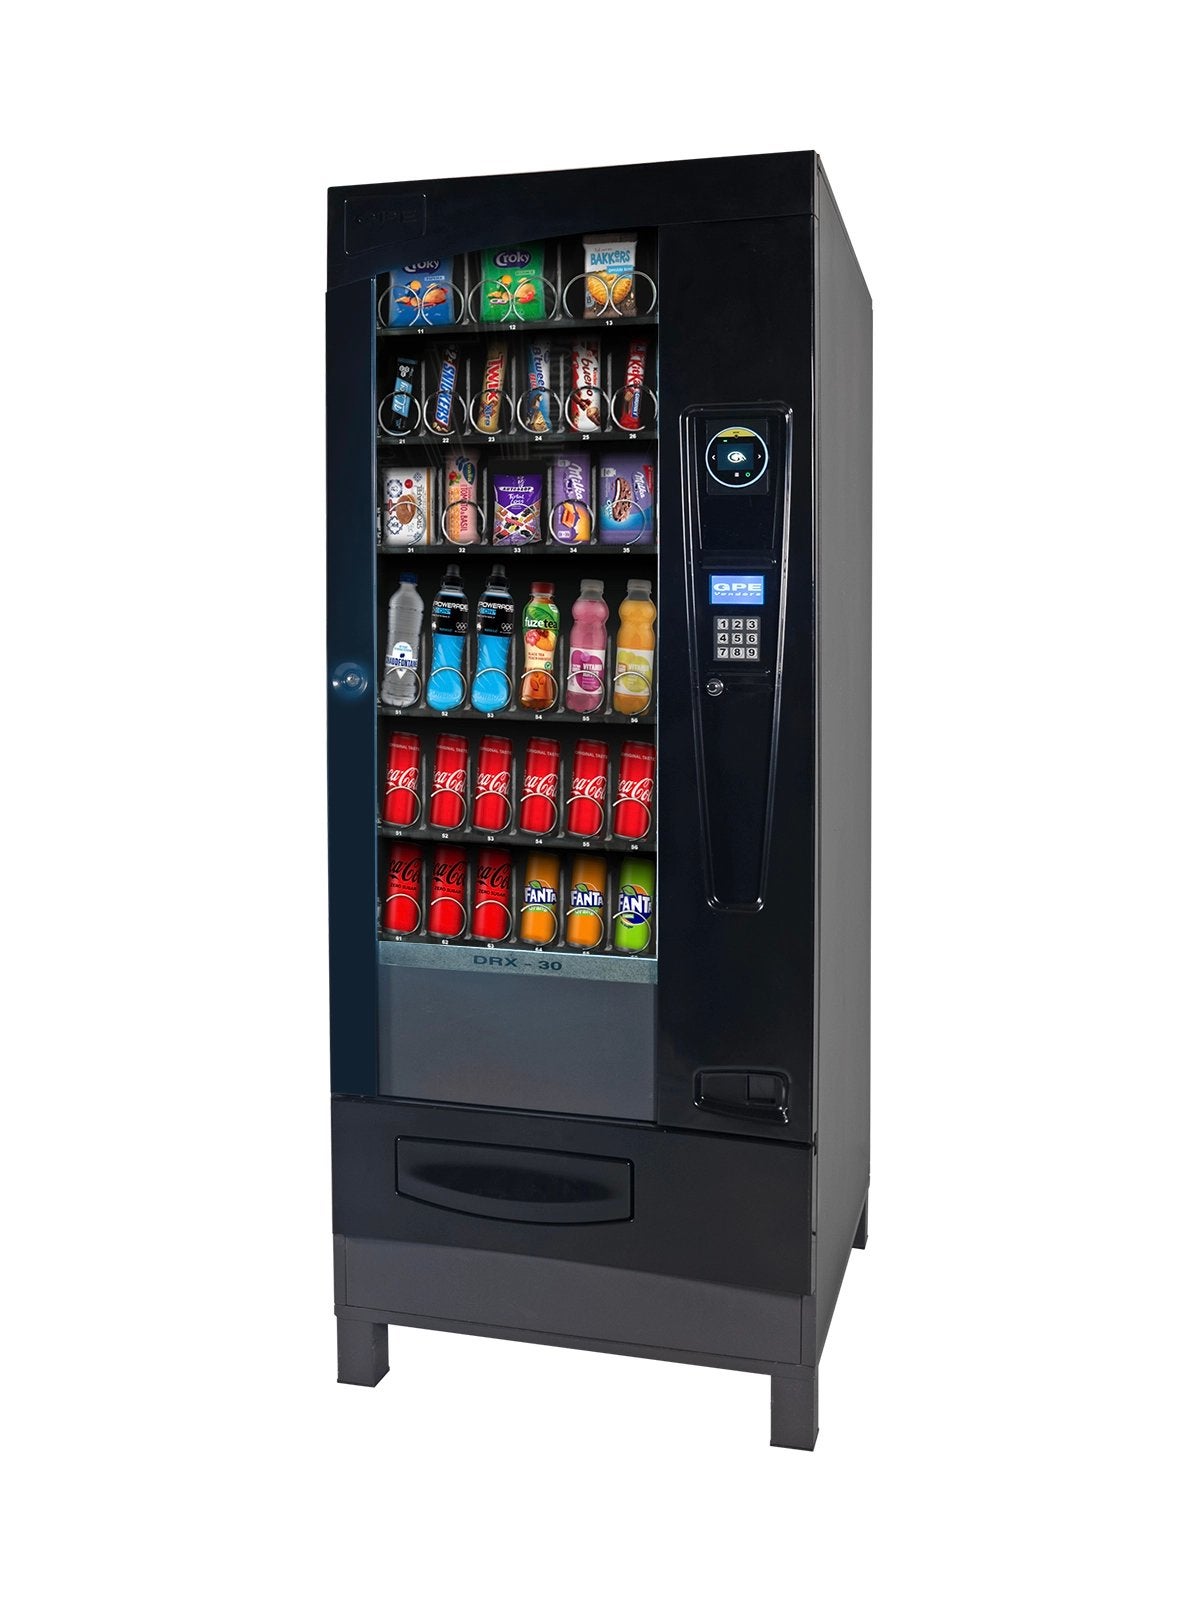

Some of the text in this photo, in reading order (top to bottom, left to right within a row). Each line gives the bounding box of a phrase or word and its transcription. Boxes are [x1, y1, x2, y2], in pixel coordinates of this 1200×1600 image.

[495, 251, 530, 267] Croky
[436, 362, 456, 425] SNICKERS
[568, 463, 585, 500] Milka
[635, 471, 647, 498] Milka
[713, 583, 762, 591] GPE
[525, 887, 557, 902] FANTA
[570, 889, 604, 906] FANTA
[473, 955, 518, 967] DRX
[538, 960, 562, 971] 30
